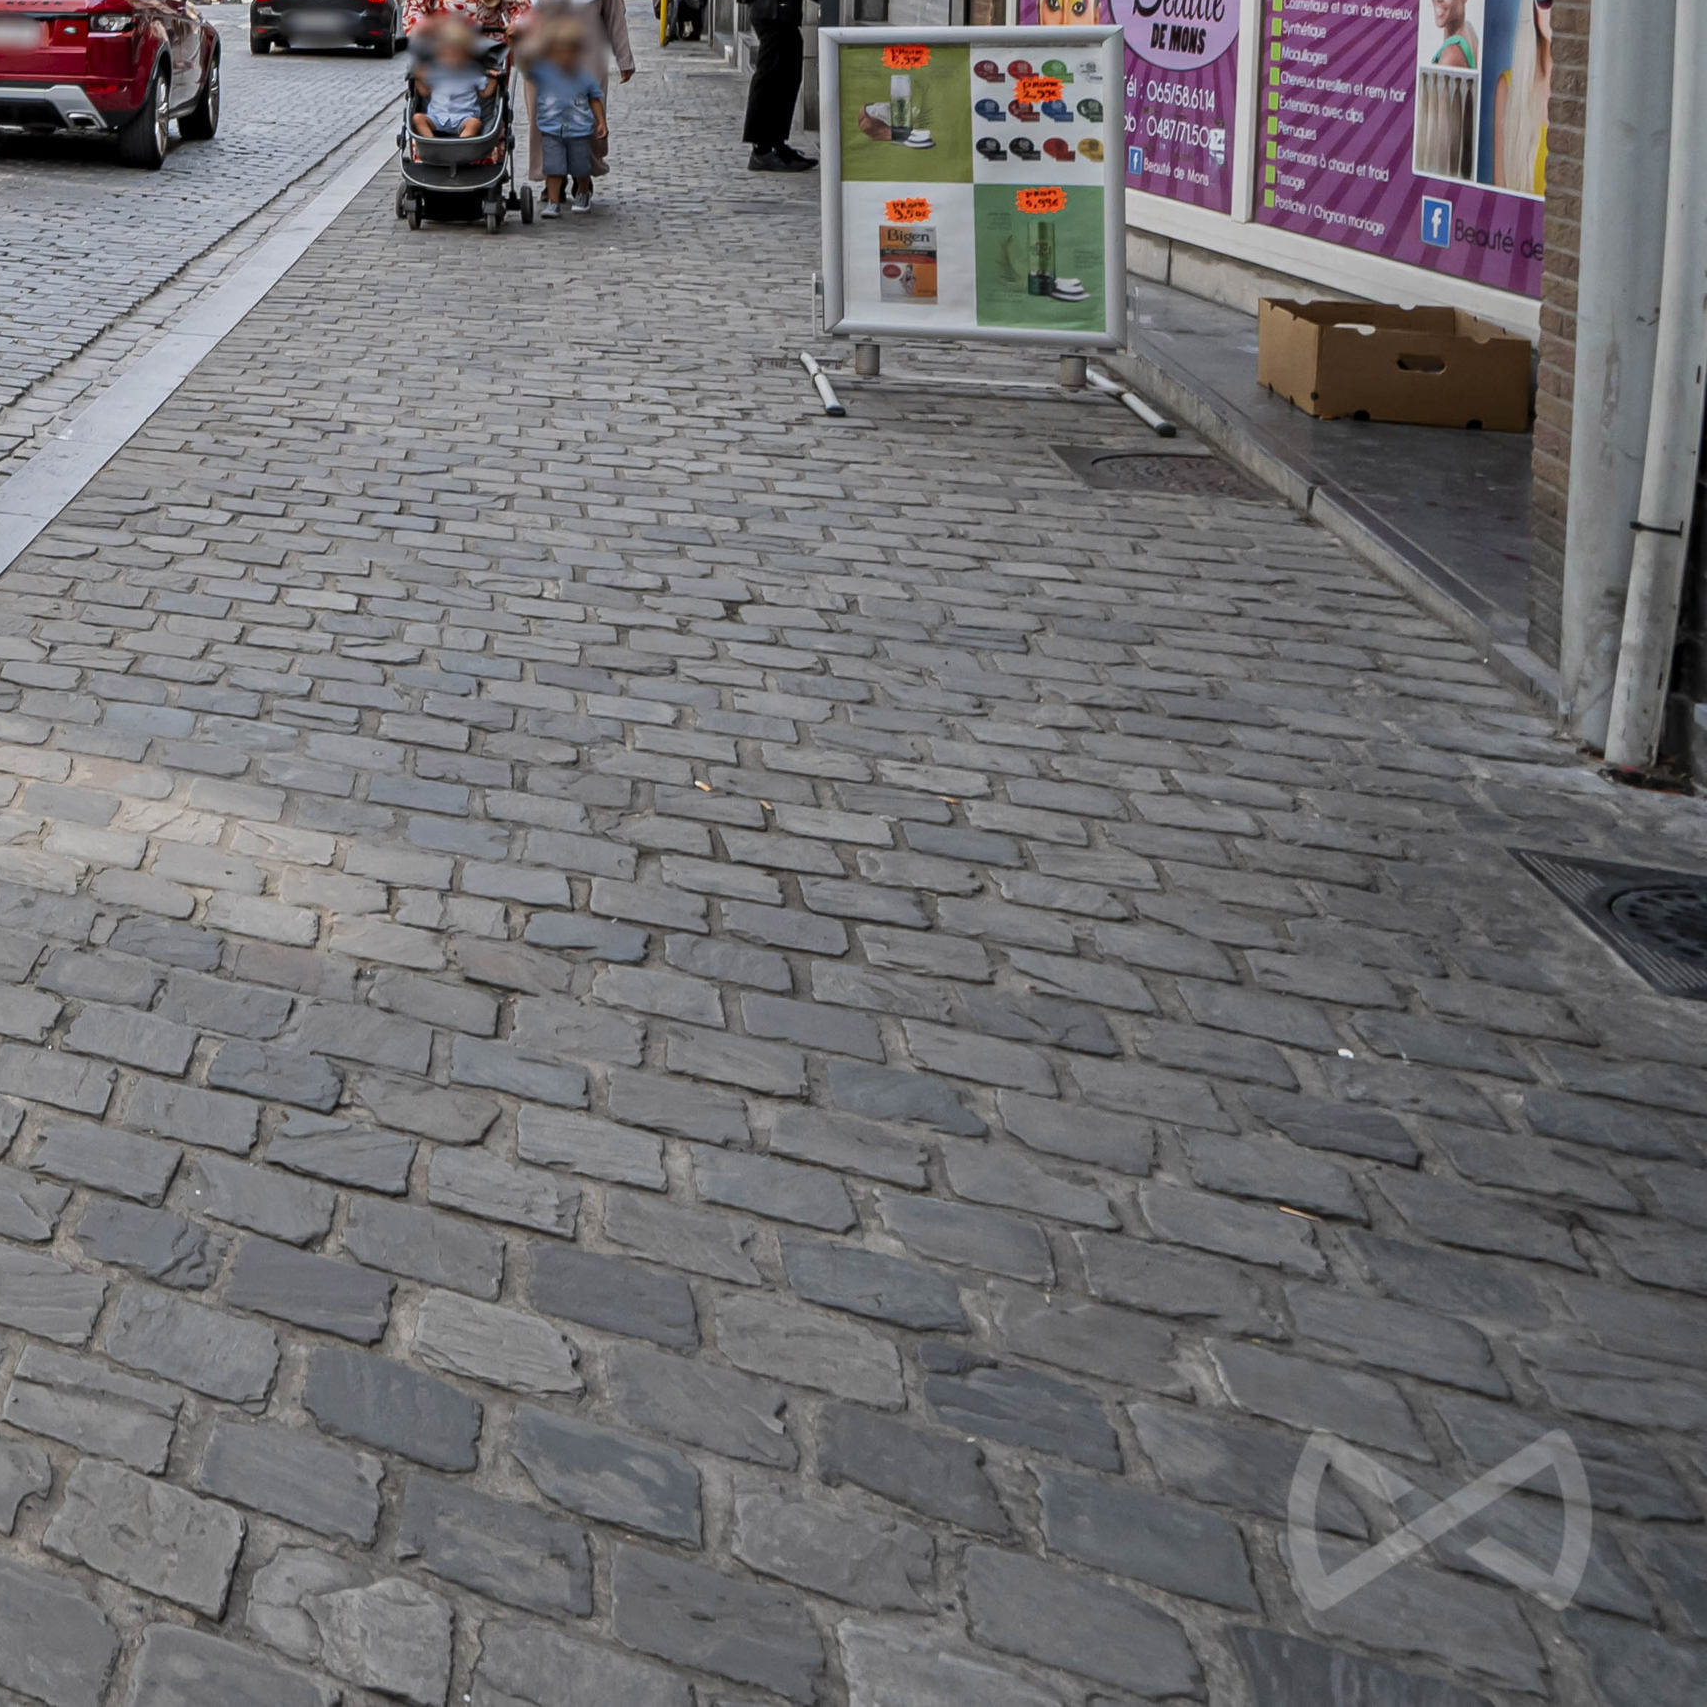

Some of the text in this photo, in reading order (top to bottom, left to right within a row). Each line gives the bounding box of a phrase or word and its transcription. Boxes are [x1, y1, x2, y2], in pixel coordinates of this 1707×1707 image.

[1330, 1, 1340, 13] et
[1342, 2, 1359, 16] soin
[1360, 3, 1373, 18] de
[1375, 5, 1413, 22] cheveux
[1150, 22, 1207, 55] DE MONS
[1282, 20, 1327, 40] Synthétique
[1281, 45, 1329, 67] Maquillages
[1280, 70, 1316, 88] Cheveux
[1353, 81, 1363, 96] et
[1365, 84, 1388, 102] remy
[1389, 87, 1407, 103] hair
[1279, 95, 1365, 124] Extensions avec clips
[1277, 120, 1317, 141] Perruques
[1143, 156, 1171, 178] Beauté
[1174, 161, 1186, 181] de
[1187, 165, 1210, 188] Mons
[1276, 145, 1390, 182] Extensions à chaud et froid
[1276, 169, 1306, 191] Tissage
[1274, 194, 1307, 215] Postiche
[1313, 204, 1347, 225] Chignon
[1348, 214, 1386, 236] mariage
[887, 228, 931, 246] Bigen
[1454, 218, 1515, 254] Beauté
[1520, 236, 1544, 262] de
